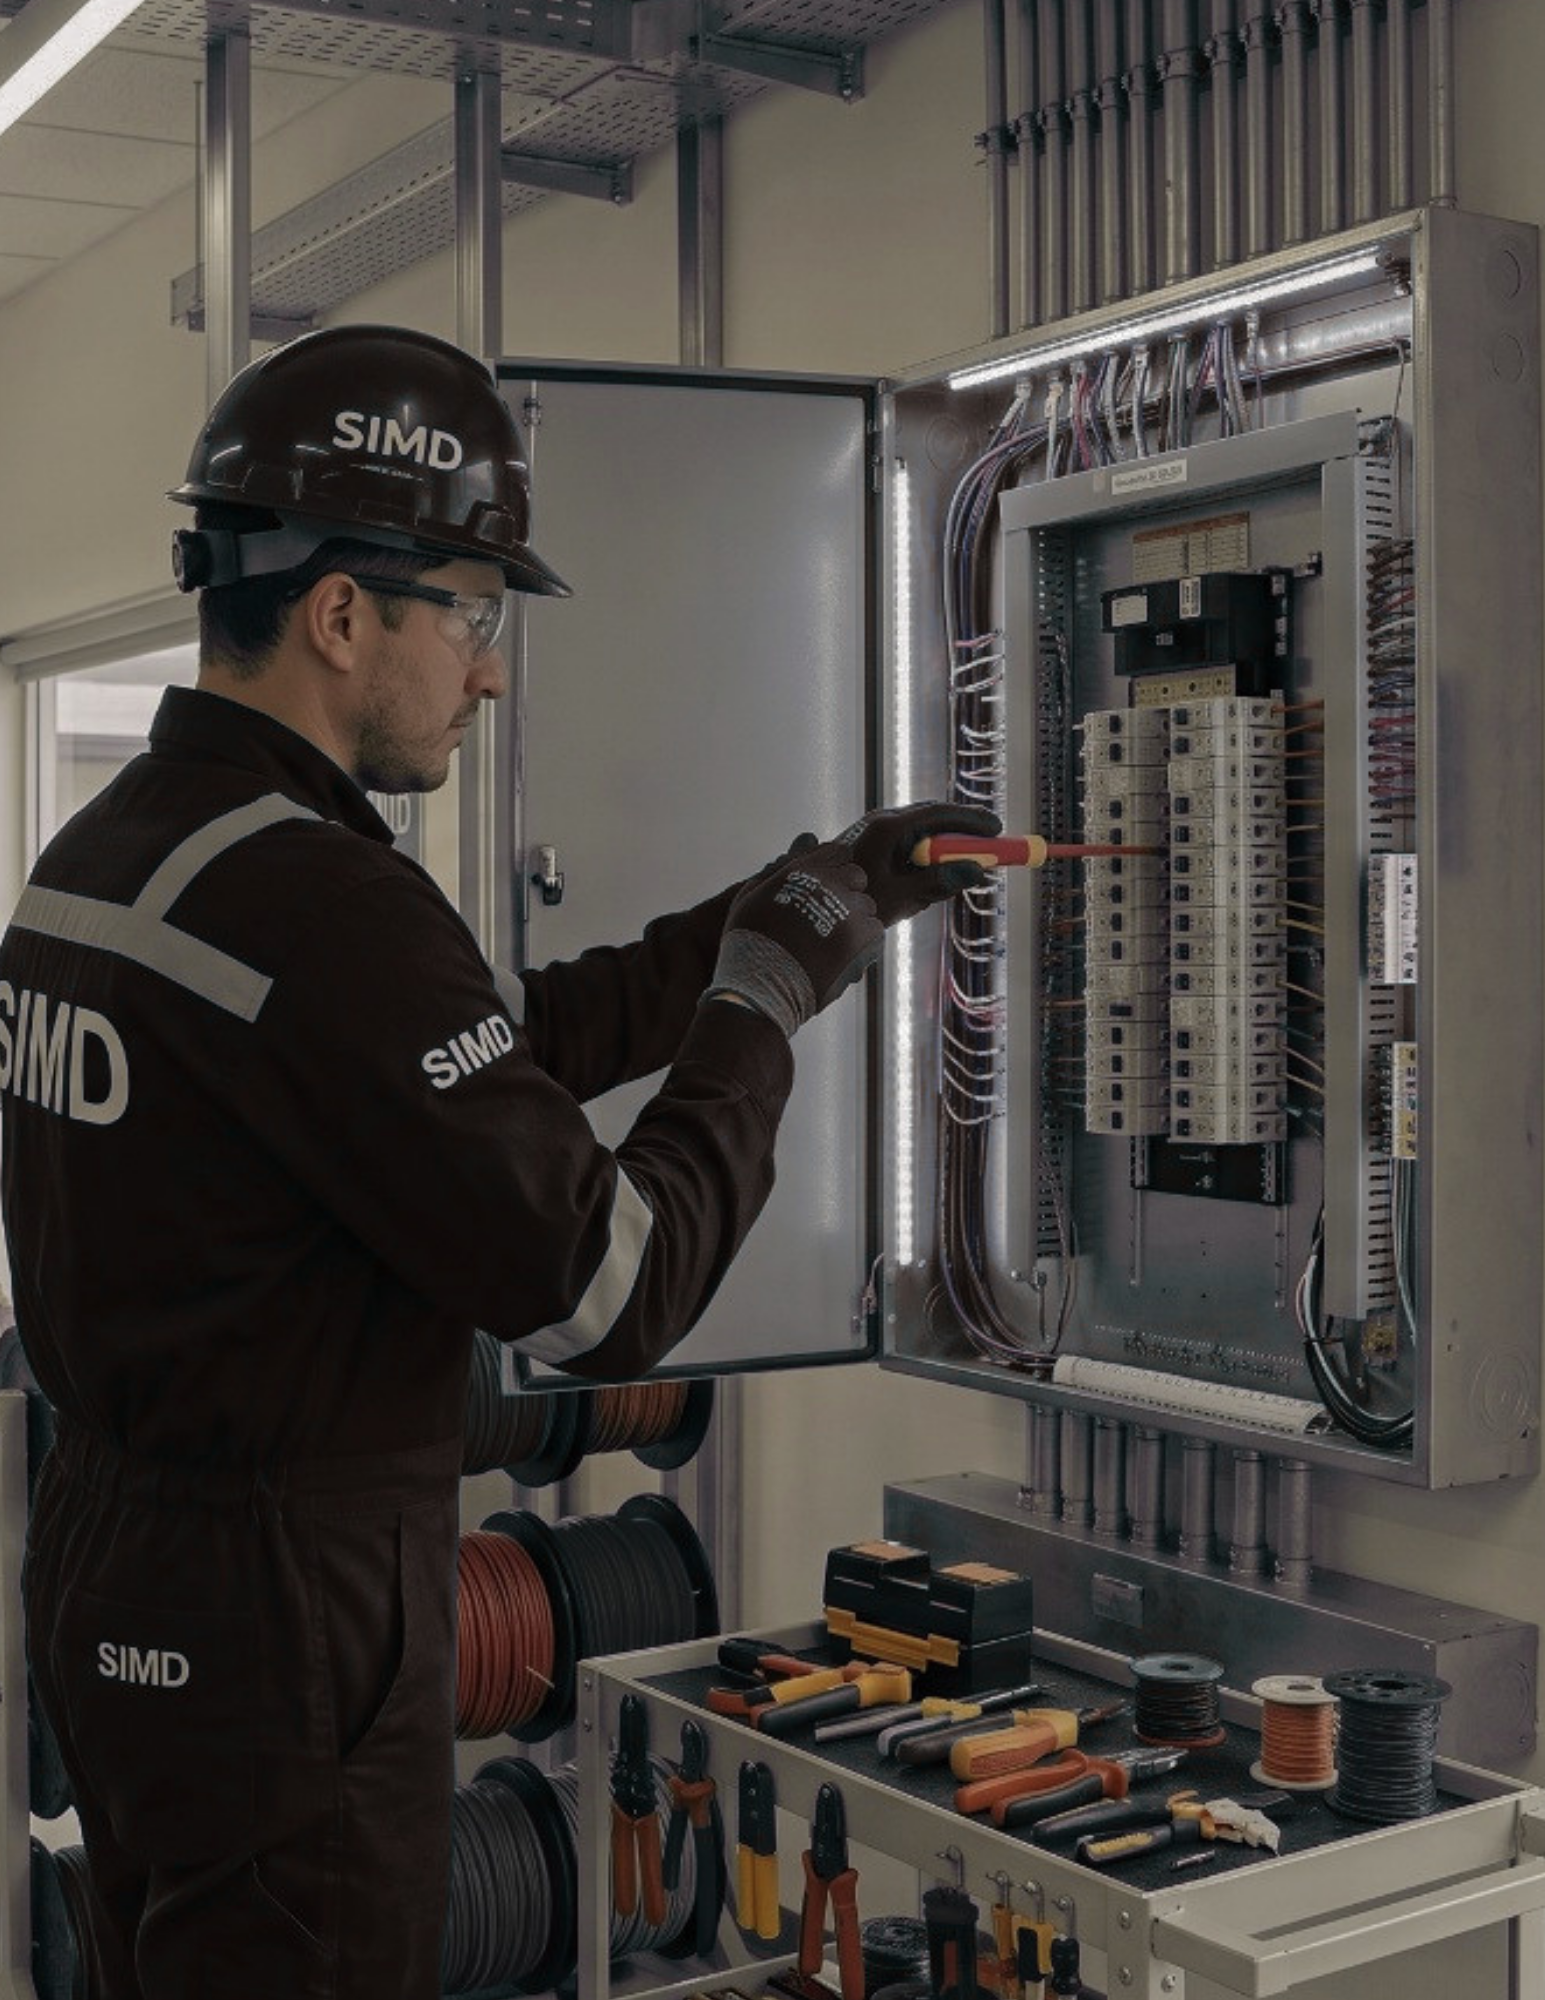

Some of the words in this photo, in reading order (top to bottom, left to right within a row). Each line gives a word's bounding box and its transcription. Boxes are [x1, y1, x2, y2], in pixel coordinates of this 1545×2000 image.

[332, 411, 463, 470] SIMD
[421, 1014, 514, 1090] SIMD
[97, 1641, 190, 1688] SIMD
